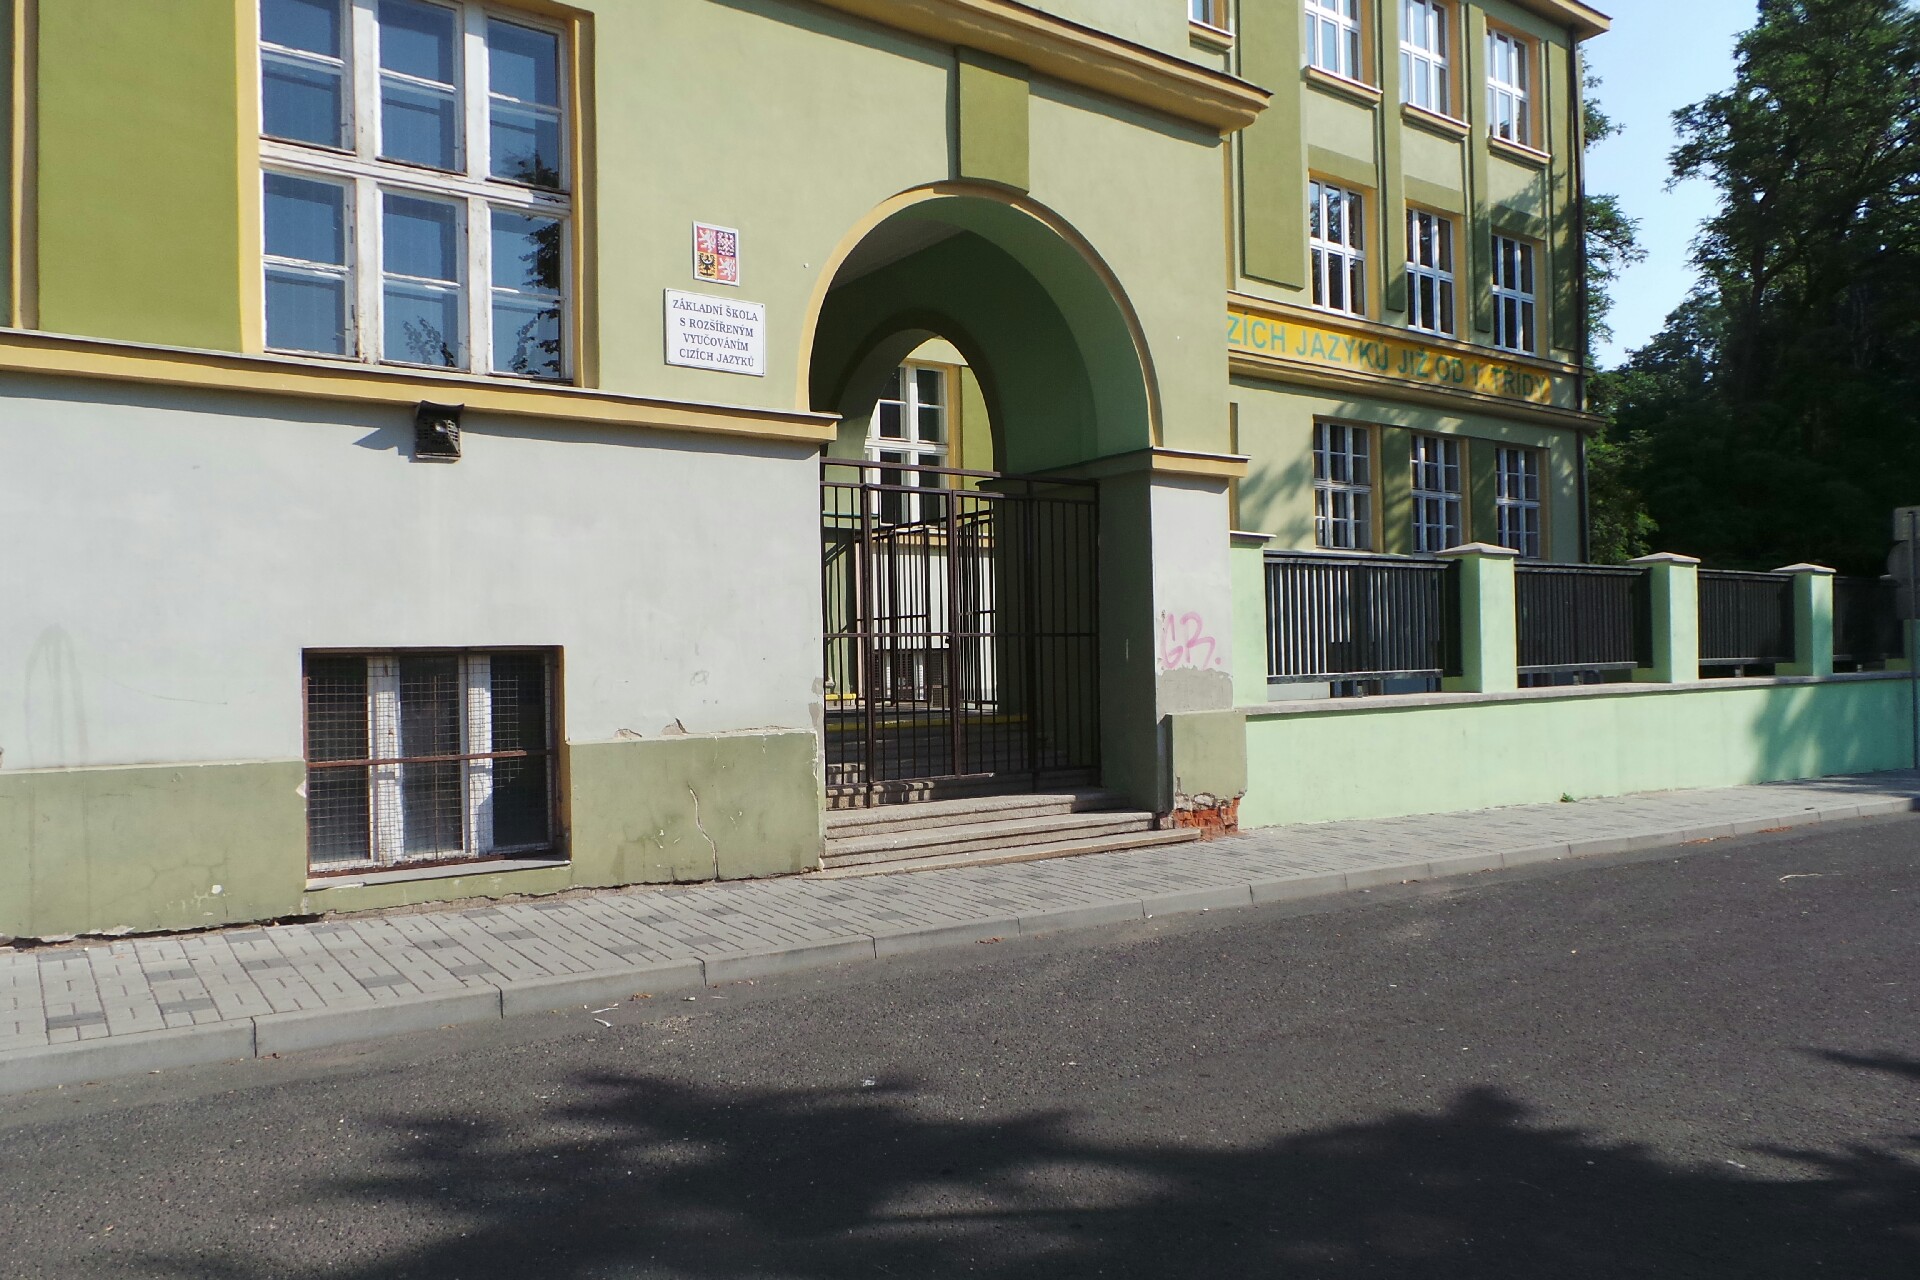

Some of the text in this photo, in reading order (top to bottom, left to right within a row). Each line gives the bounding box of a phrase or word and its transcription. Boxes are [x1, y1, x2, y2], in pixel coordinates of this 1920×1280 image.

[673, 298, 759, 322] ZÁKLADNÍ ŠKOLA
[679, 317, 754, 338] S ROZŠÍŘENÝM
[683, 333, 749, 352] VYUČOVÁNÍM
[679, 348, 754, 367] CIZÍCH JAZYKŮ
[1295, 330, 1389, 371] JAZYKŮ
[1397, 347, 1430, 379] JIŽ
[1434, 354, 1466, 384] OD
[1491, 364, 1550, 400] TŘÍDY
